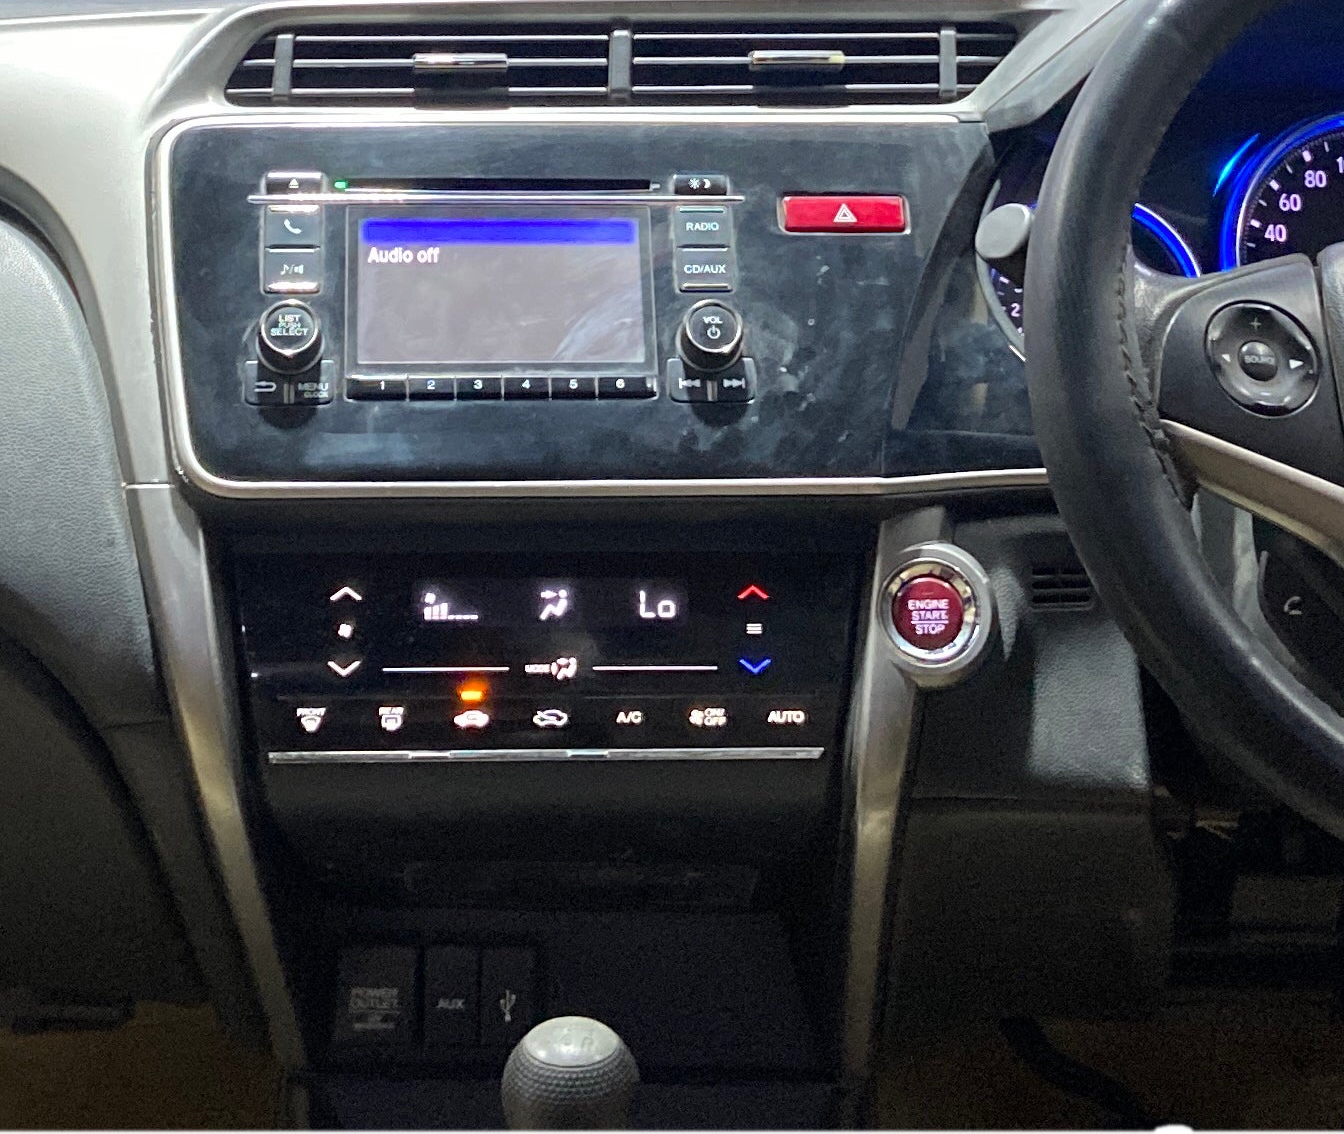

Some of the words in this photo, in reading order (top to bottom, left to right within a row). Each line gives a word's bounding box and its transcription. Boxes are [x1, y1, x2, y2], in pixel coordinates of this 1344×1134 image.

[1304, 170, 1327, 188] 80
[1278, 193, 1302, 212] 60
[686, 222, 719, 231] RADIO
[1264, 224, 1287, 242] 40
[367, 246, 413, 263] Audio
[417, 246, 440, 263] off
[684, 264, 726, 274] CD/AUX
[1010, 302, 1021, 317] 2
[278, 314, 301, 322] LIST
[703, 316, 723, 324] VOL
[271, 327, 308, 336] SELECT
[297, 382, 329, 391] MENU
[379, 380, 386, 390] 1
[426, 379, 436, 390] 2
[473, 379, 483, 390] 3
[521, 378, 531, 389] 4
[569, 378, 578, 389] 5
[615, 378, 625, 389] 6
[639, 590, 676, 618] Lo
[908, 598, 950, 610] ENGINE
[911, 610, 948, 620] START
[915, 623, 945, 635] STOP
[616, 711, 642, 723] A/C
[767, 710, 805, 723] AUTO
[435, 998, 465, 1009] AUX
